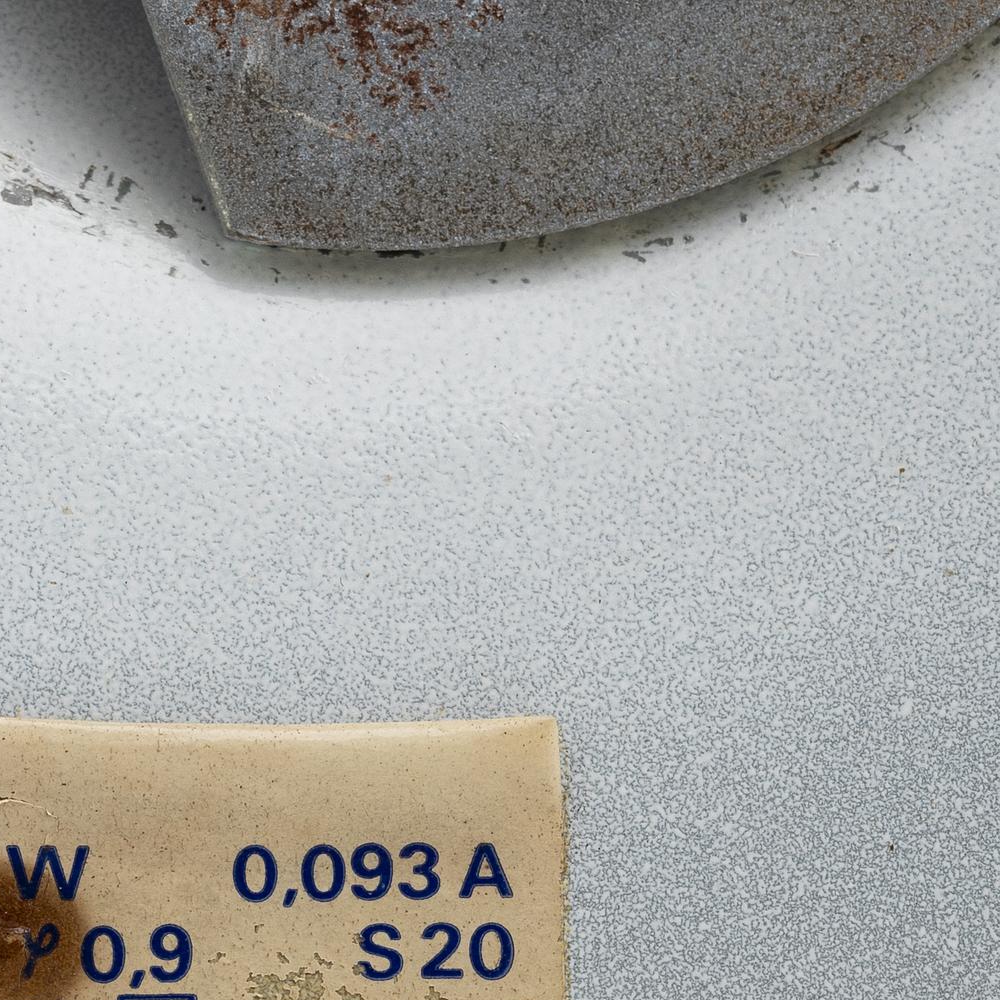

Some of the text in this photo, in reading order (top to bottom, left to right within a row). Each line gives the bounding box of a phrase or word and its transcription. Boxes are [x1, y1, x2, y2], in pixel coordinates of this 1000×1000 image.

[232, 842, 513, 908] 0,093 A
[80, 923, 193, 989] 0,9
[357, 922, 515, 981] S 20
